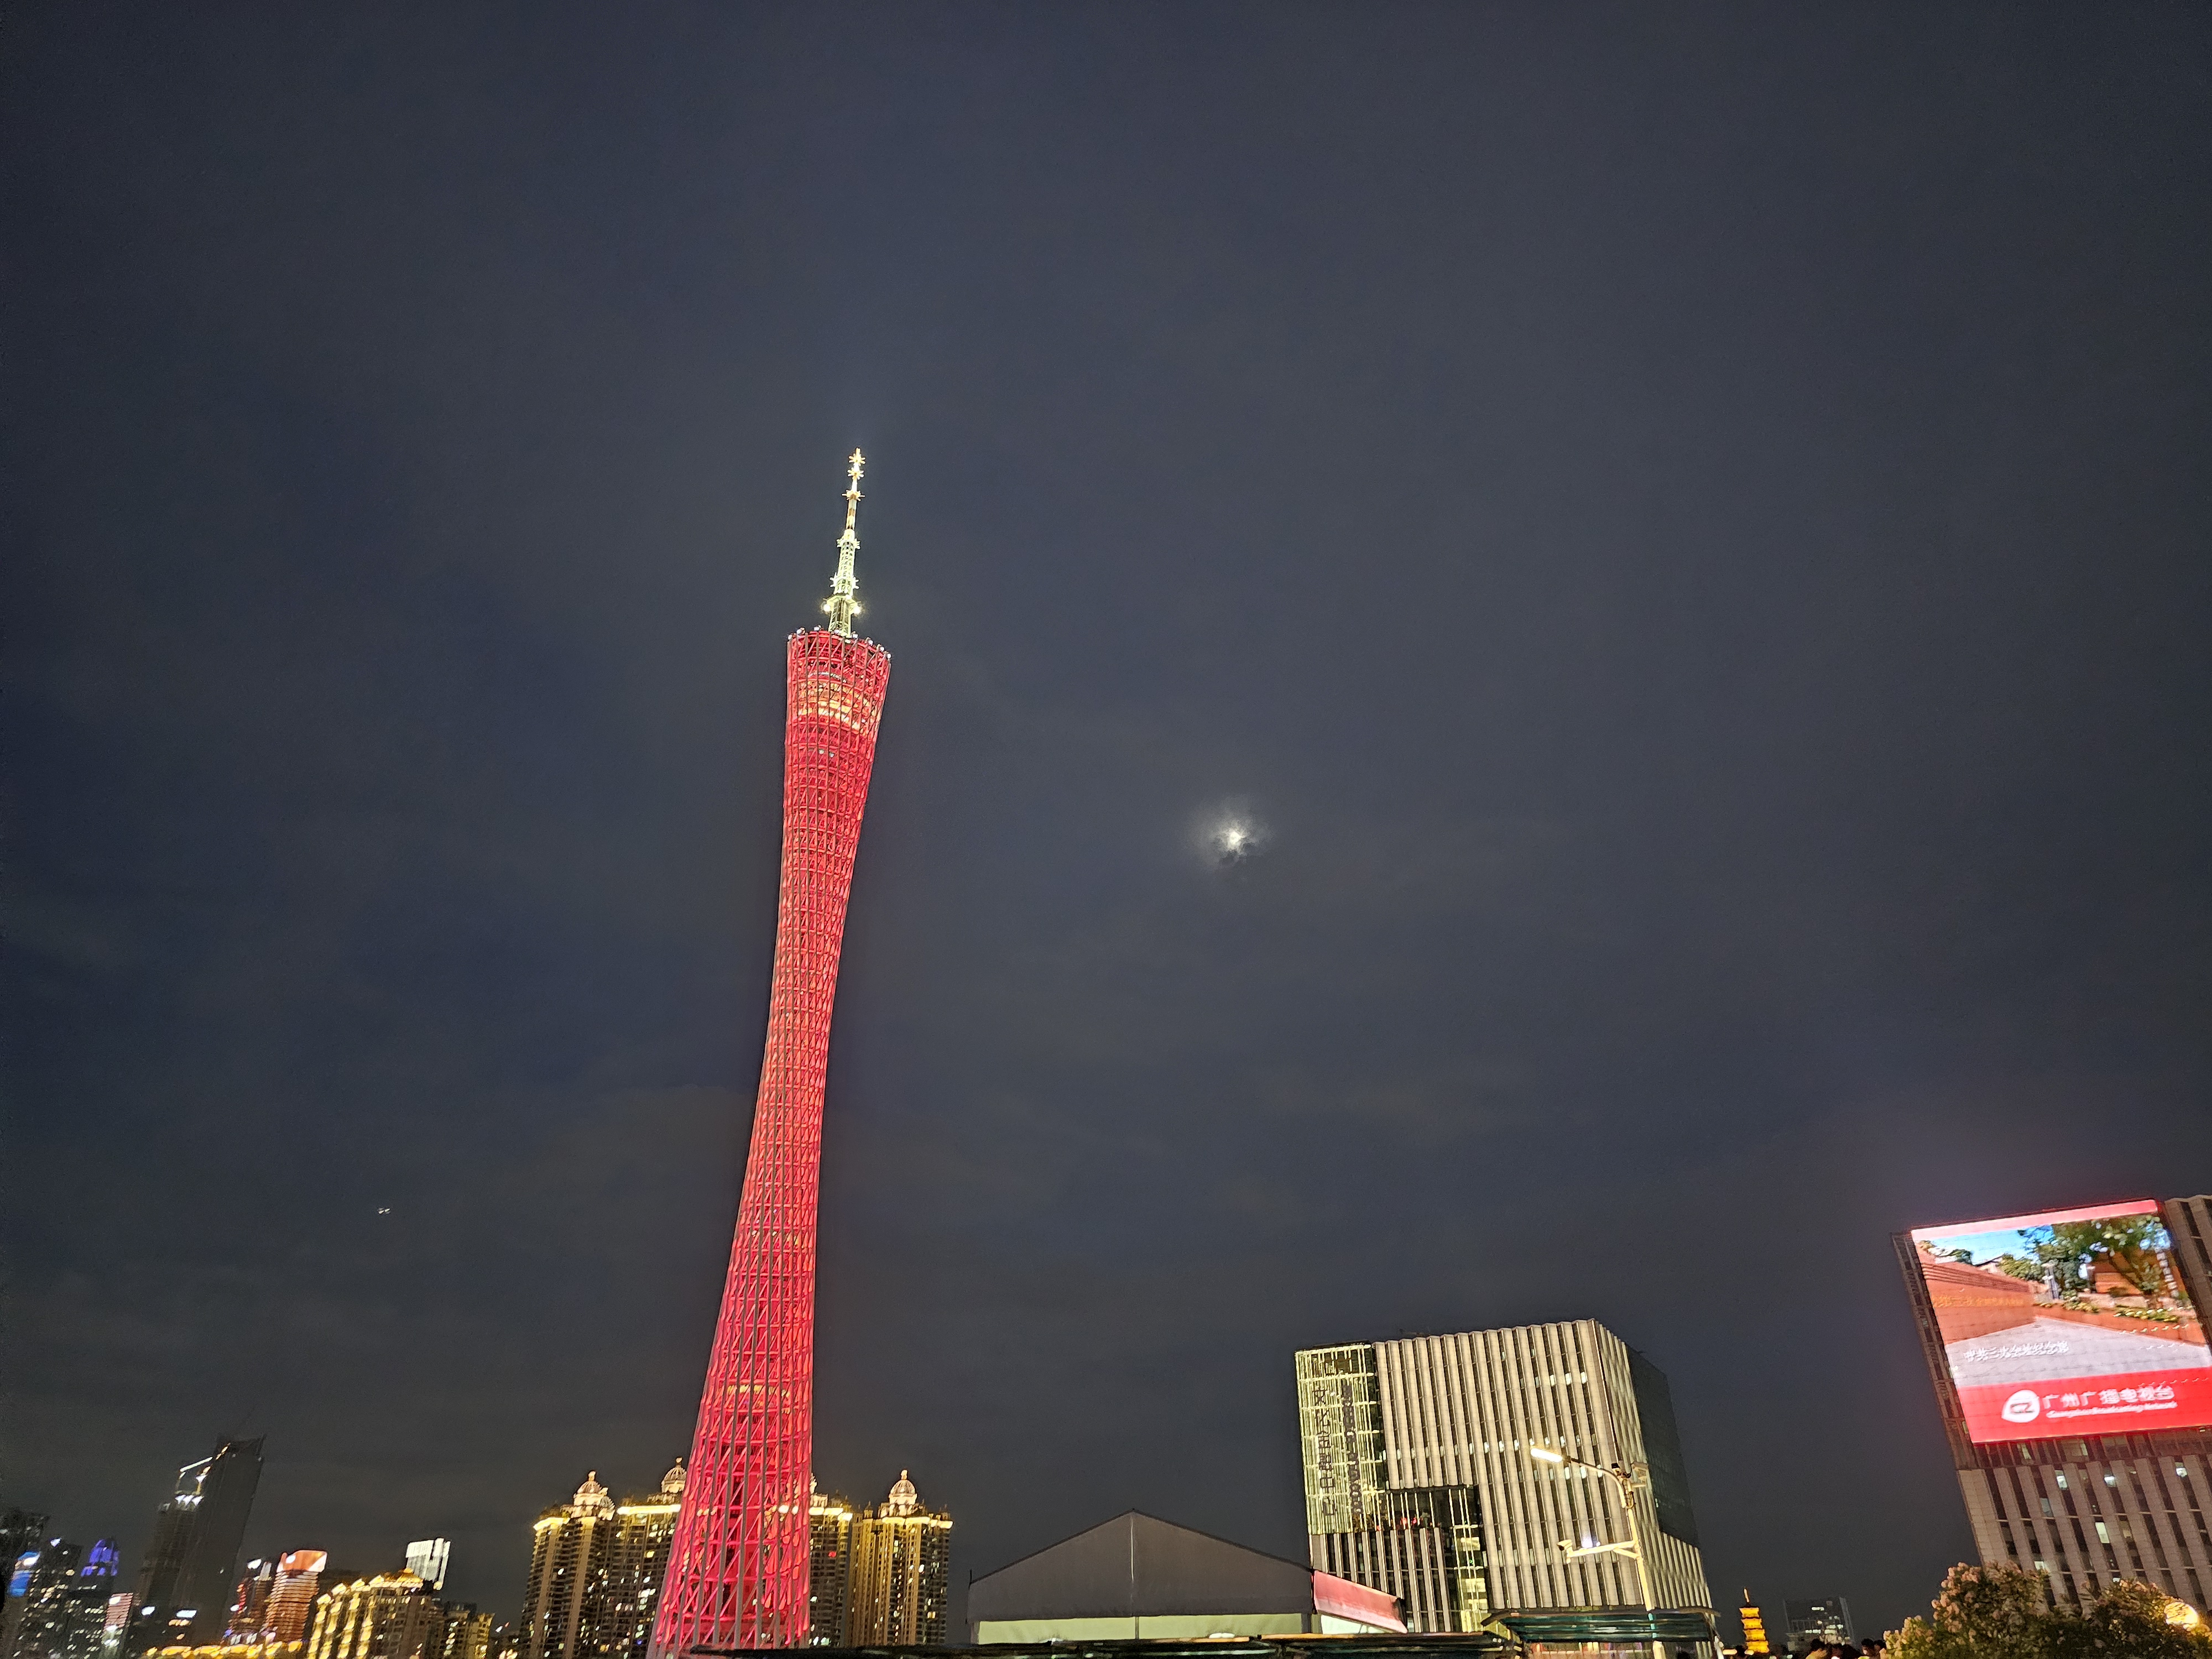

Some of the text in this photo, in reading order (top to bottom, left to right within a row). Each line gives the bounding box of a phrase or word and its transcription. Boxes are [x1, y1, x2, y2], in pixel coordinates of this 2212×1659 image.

[2042, 1385, 2175, 1409] 广州广播电视台
